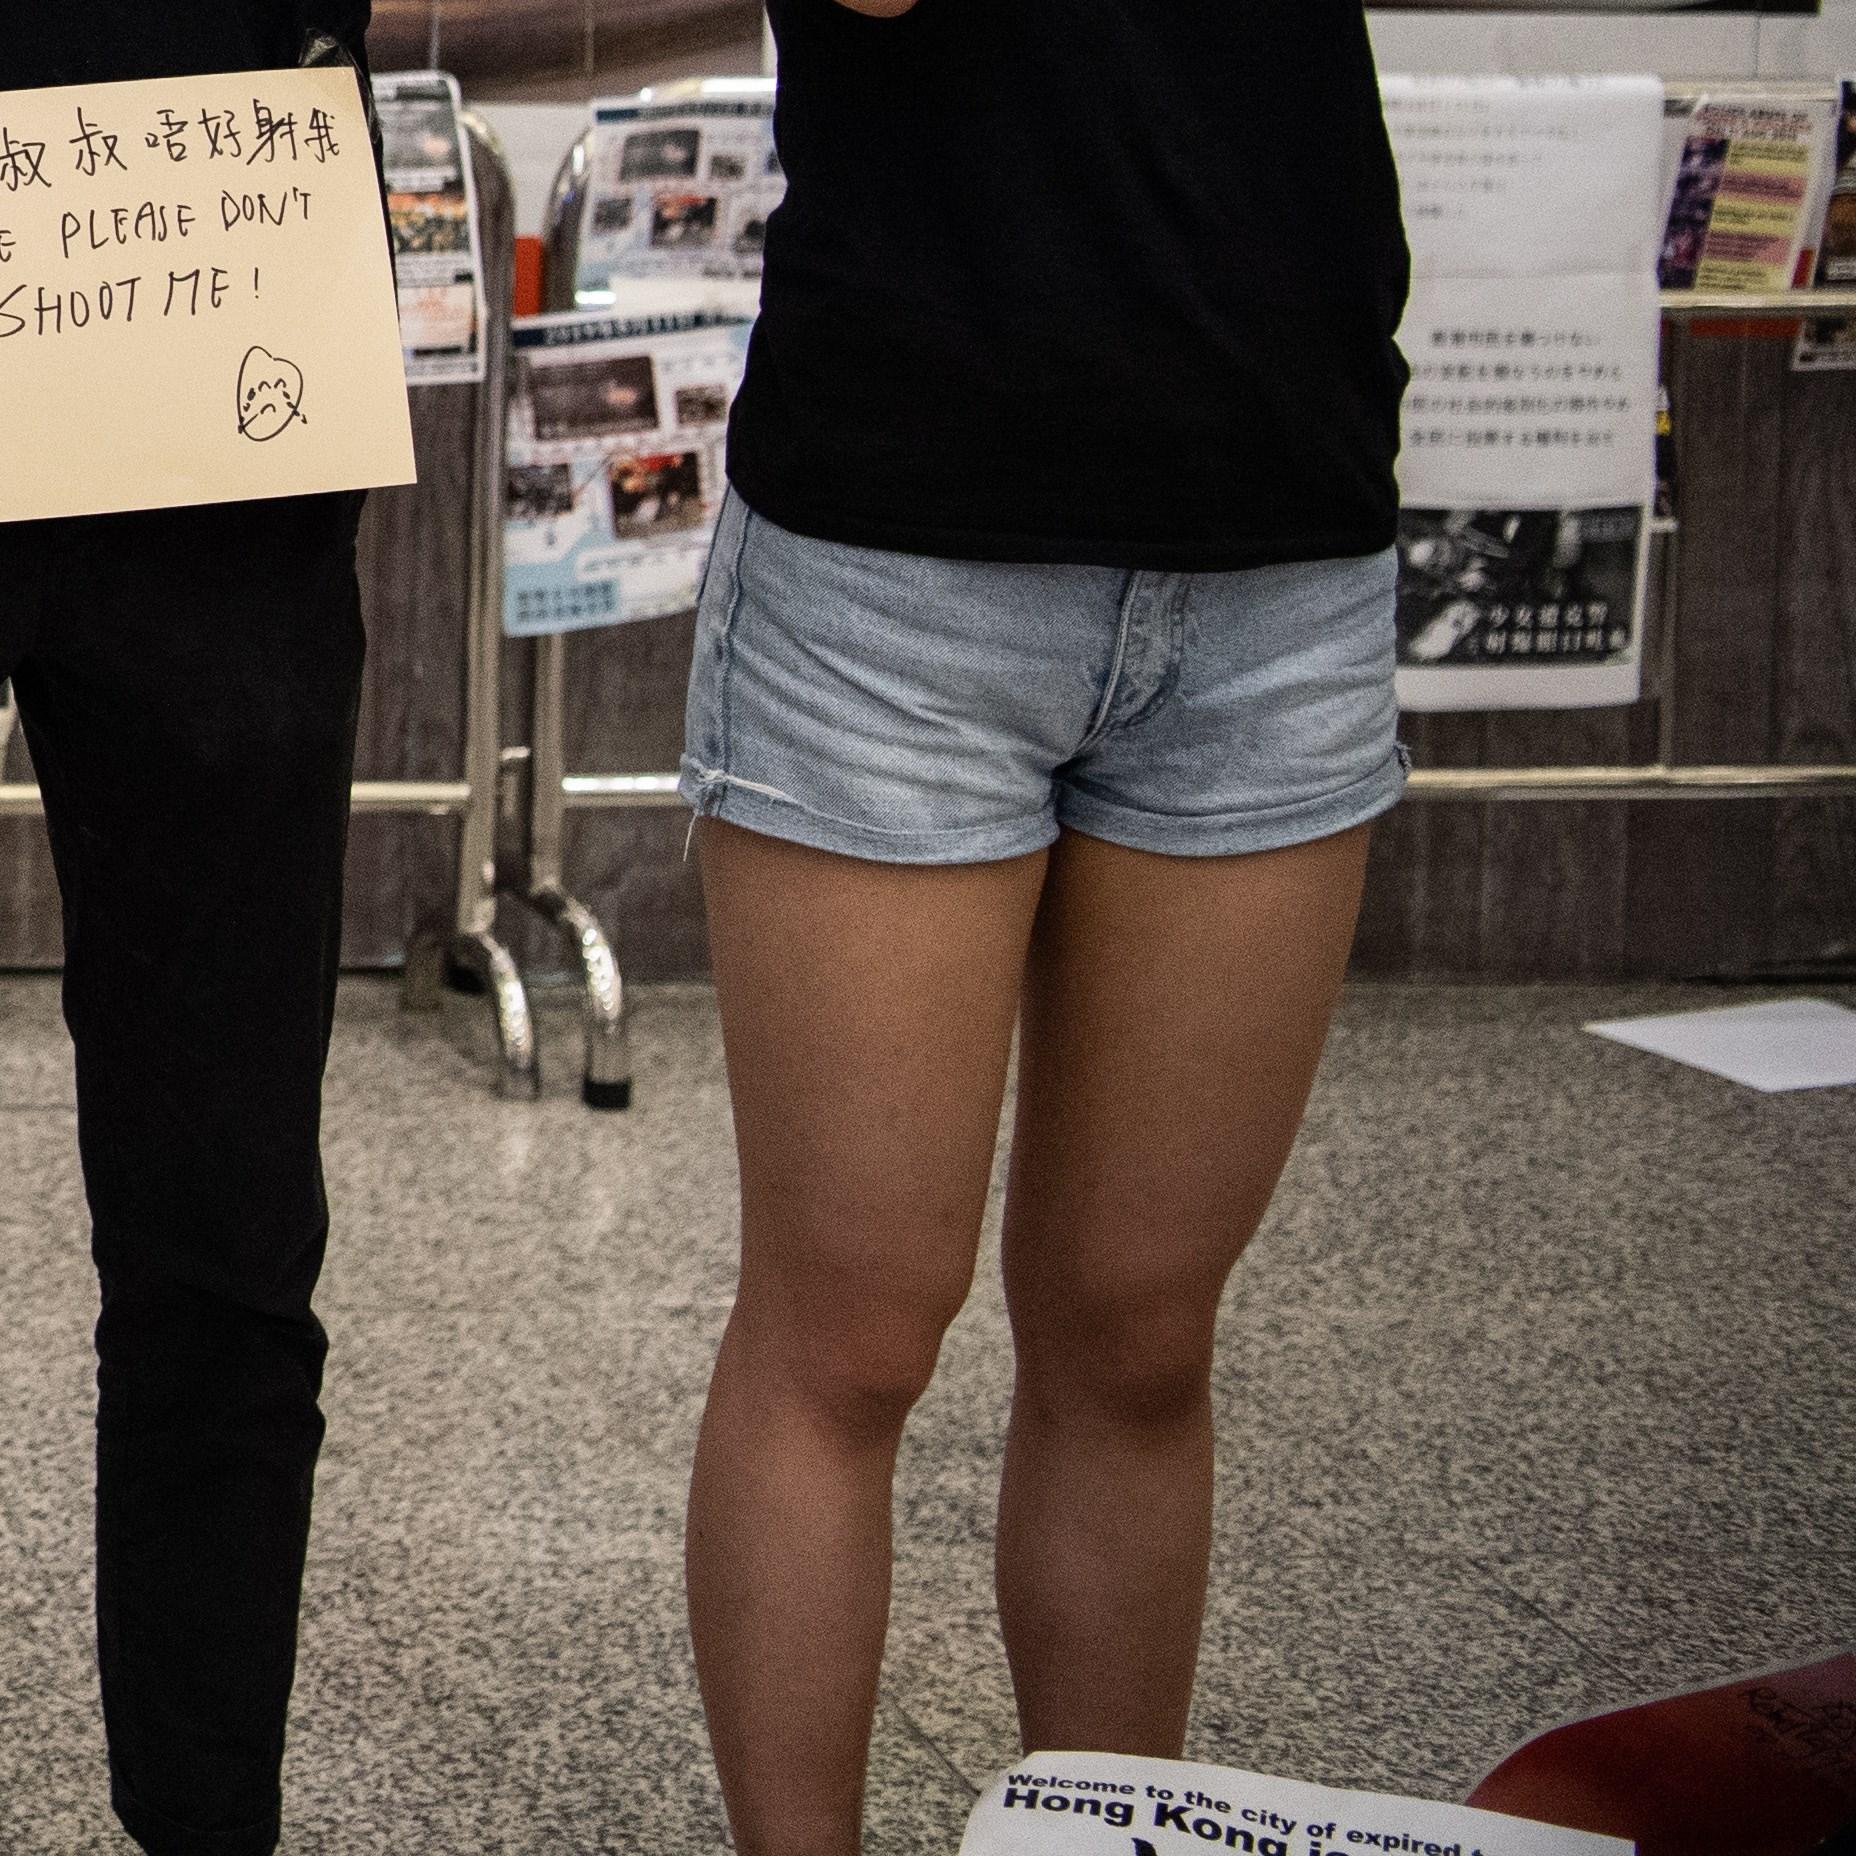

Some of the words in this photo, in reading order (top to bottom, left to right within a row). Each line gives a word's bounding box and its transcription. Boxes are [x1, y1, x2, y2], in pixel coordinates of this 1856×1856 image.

[61, 200, 196, 258] PLEASE
[221, 186, 312, 232] DON'T
[163, 267, 230, 316] ME
[1003, 1787, 1135, 1827] Hong
[1154, 1802, 1290, 1856] Kong
[1007, 1773, 1136, 1796] Welcome
[1145, 1785, 1174, 1801] to
[1184, 1791, 1232, 1814] the
[1241, 1808, 1297, 1834] city
[1307, 1822, 1337, 1840] of
[1346, 1829, 1461, 1856] expired
